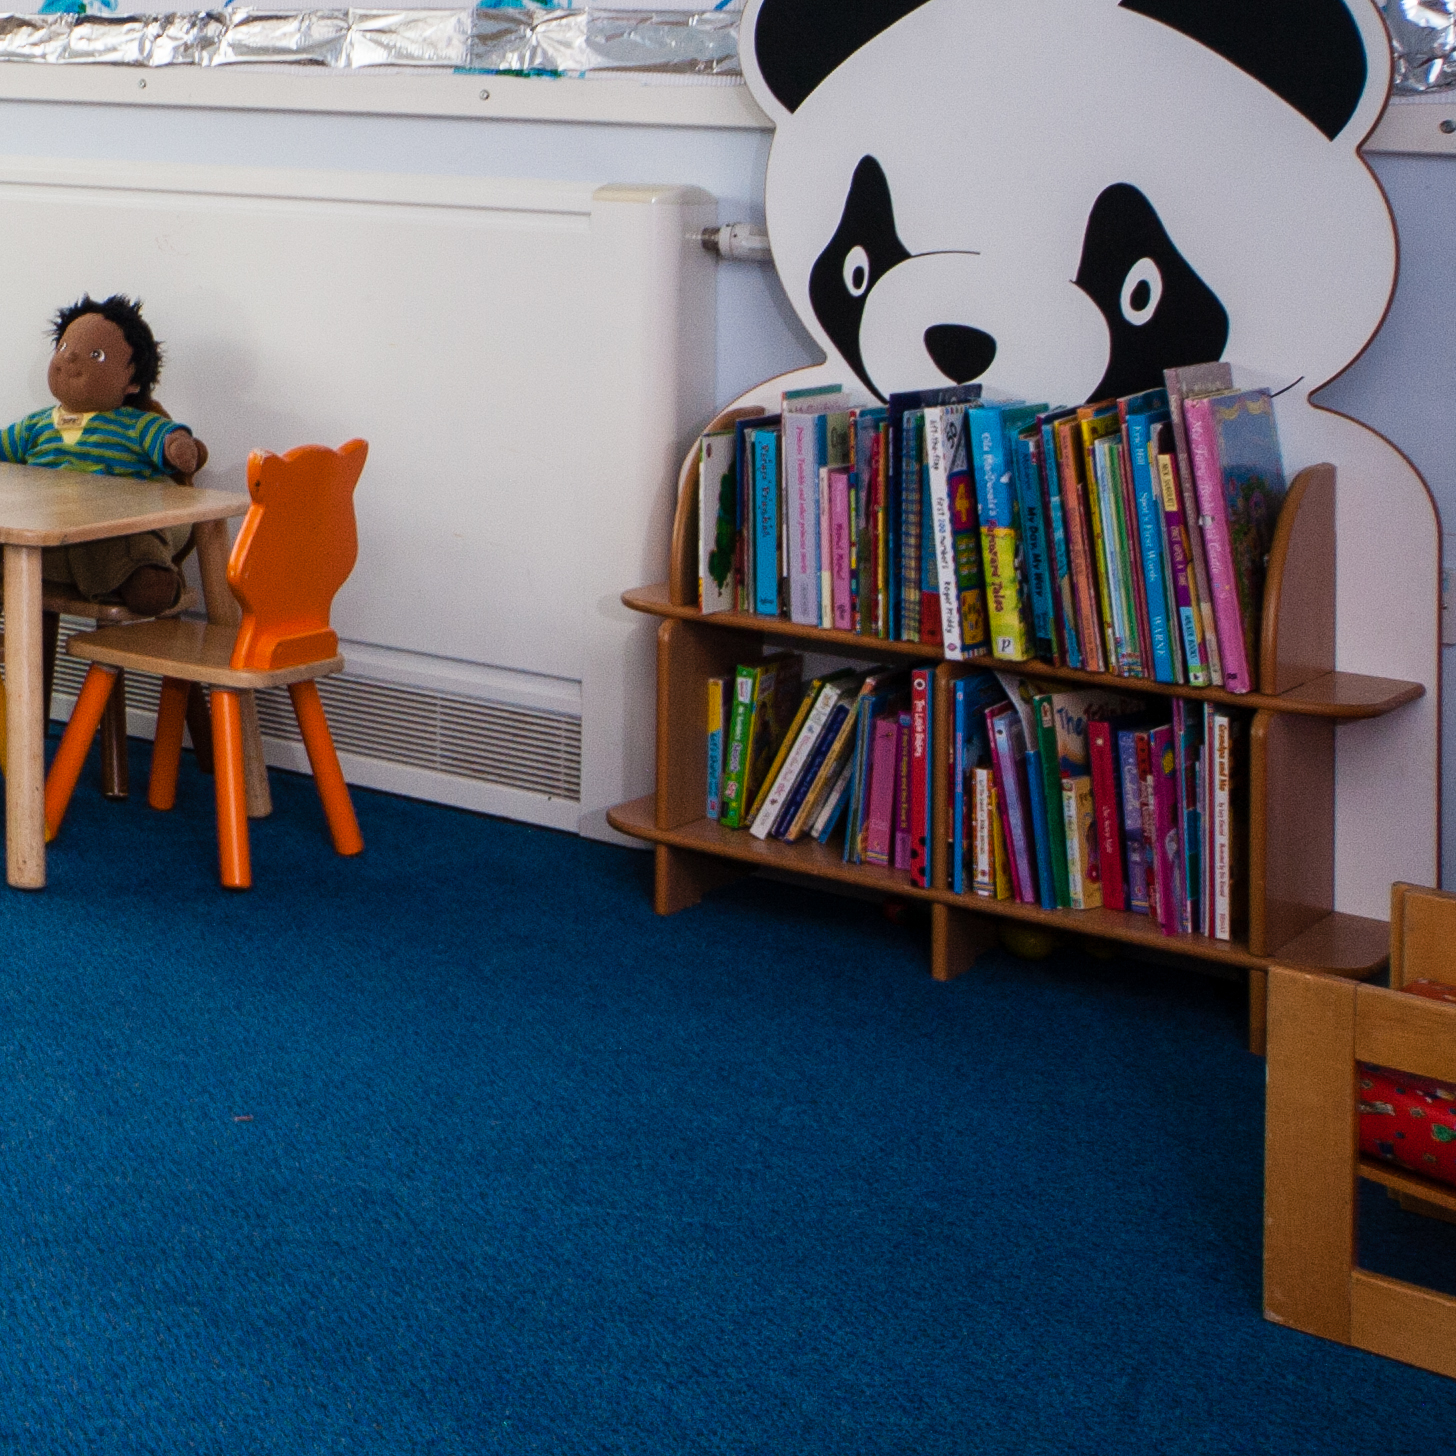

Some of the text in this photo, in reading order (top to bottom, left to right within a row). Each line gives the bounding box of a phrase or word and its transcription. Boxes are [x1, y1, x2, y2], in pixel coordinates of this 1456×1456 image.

[1134, 447, 1146, 466] Hill
[934, 496, 946, 516] first
[1026, 506, 1036, 523] My
[1137, 491, 1152, 522] Spot's
[1142, 523, 1155, 548] First
[1031, 552, 1042, 570] My
[1145, 549, 1159, 583] Words
[1175, 560, 1185, 569] A
[990, 580, 1006, 612] Tales
[1033, 571, 1045, 597] Way
[1151, 615, 1166, 658] WARNE
[1217, 724, 1227, 758] Grandpa
[1218, 761, 1226, 776] and
